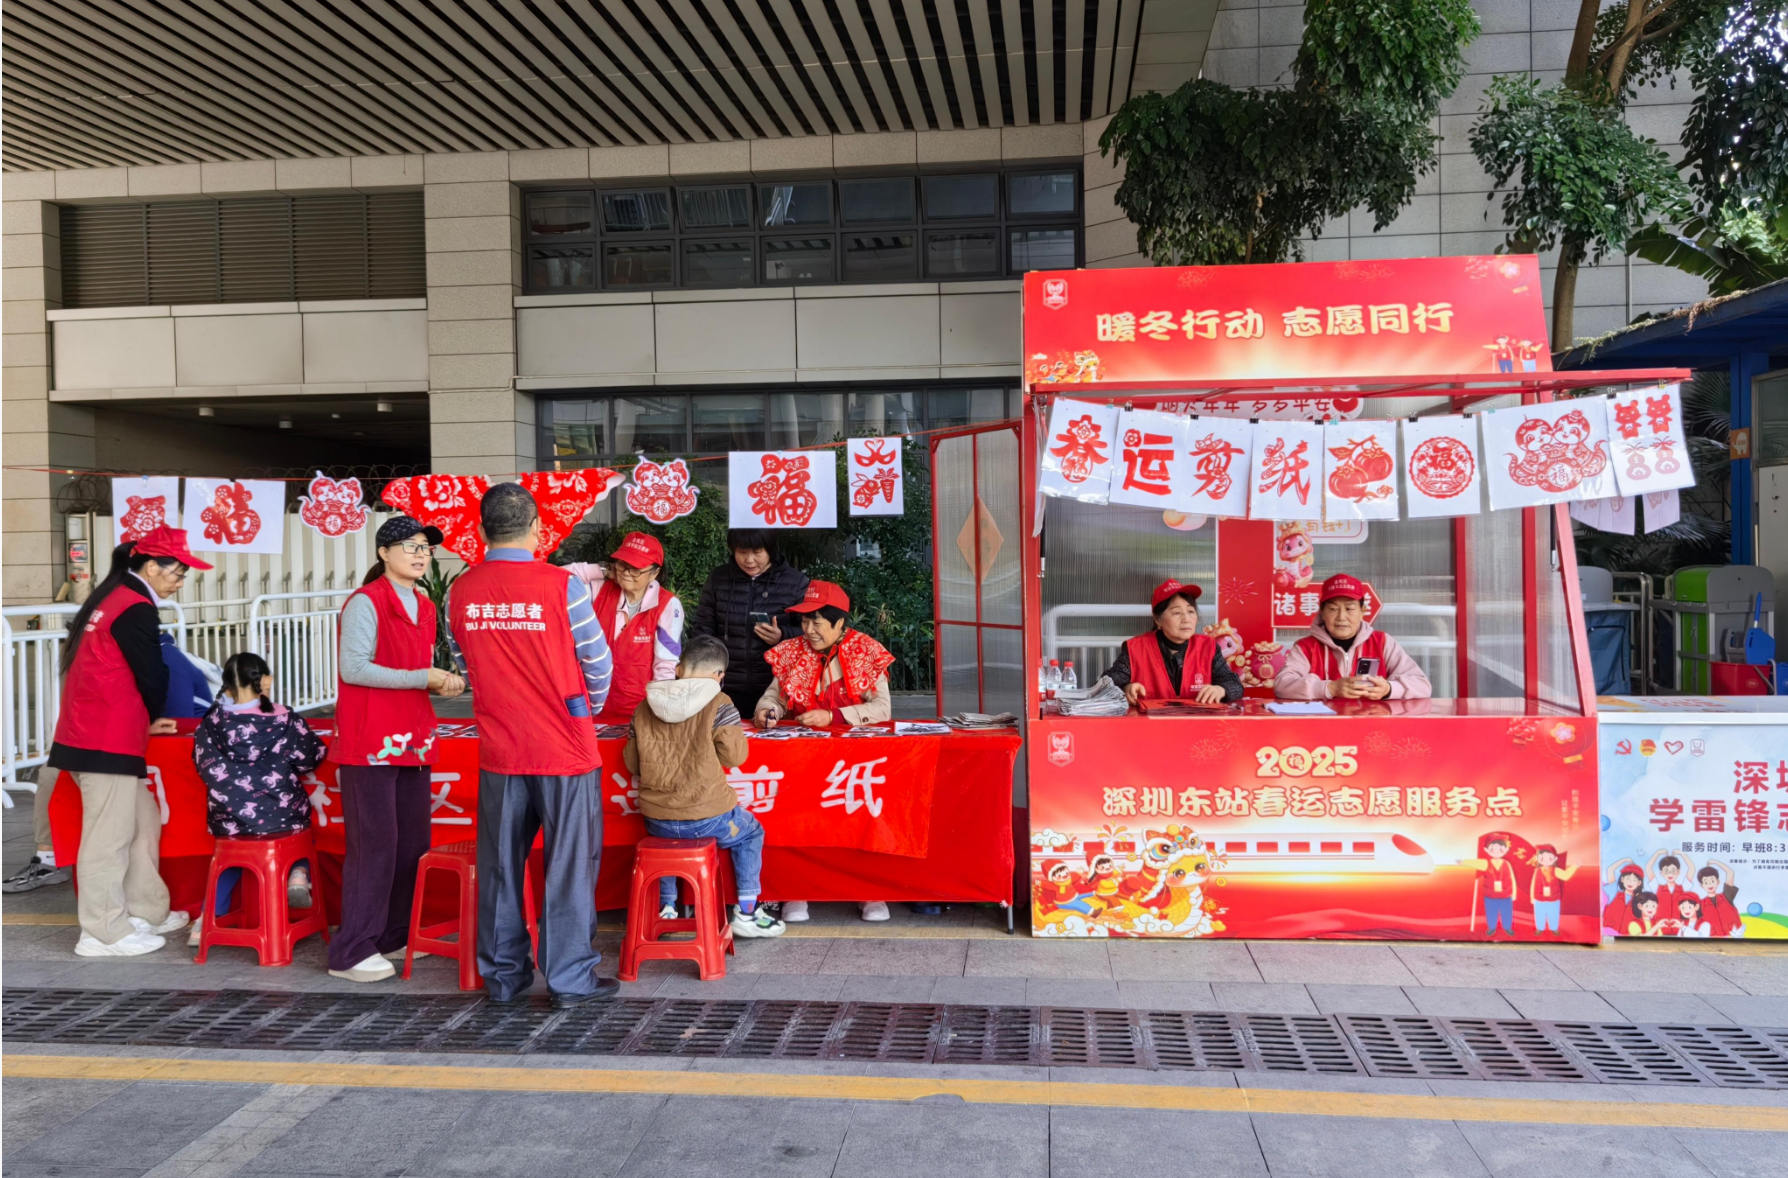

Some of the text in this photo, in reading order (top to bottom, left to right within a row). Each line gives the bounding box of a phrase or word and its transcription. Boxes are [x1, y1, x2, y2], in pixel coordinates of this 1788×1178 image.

[1096, 302, 1455, 343] 暖冬行动 志愿同行
[747, 454, 818, 527] 福
[465, 603, 543, 619] 布吉志愿者
[465, 621, 546, 631] BU JI VOLUNTEER
[1255, 745, 1358, 777] 2025
[1102, 785, 1524, 818] 深圳东站春运志愿服务点
